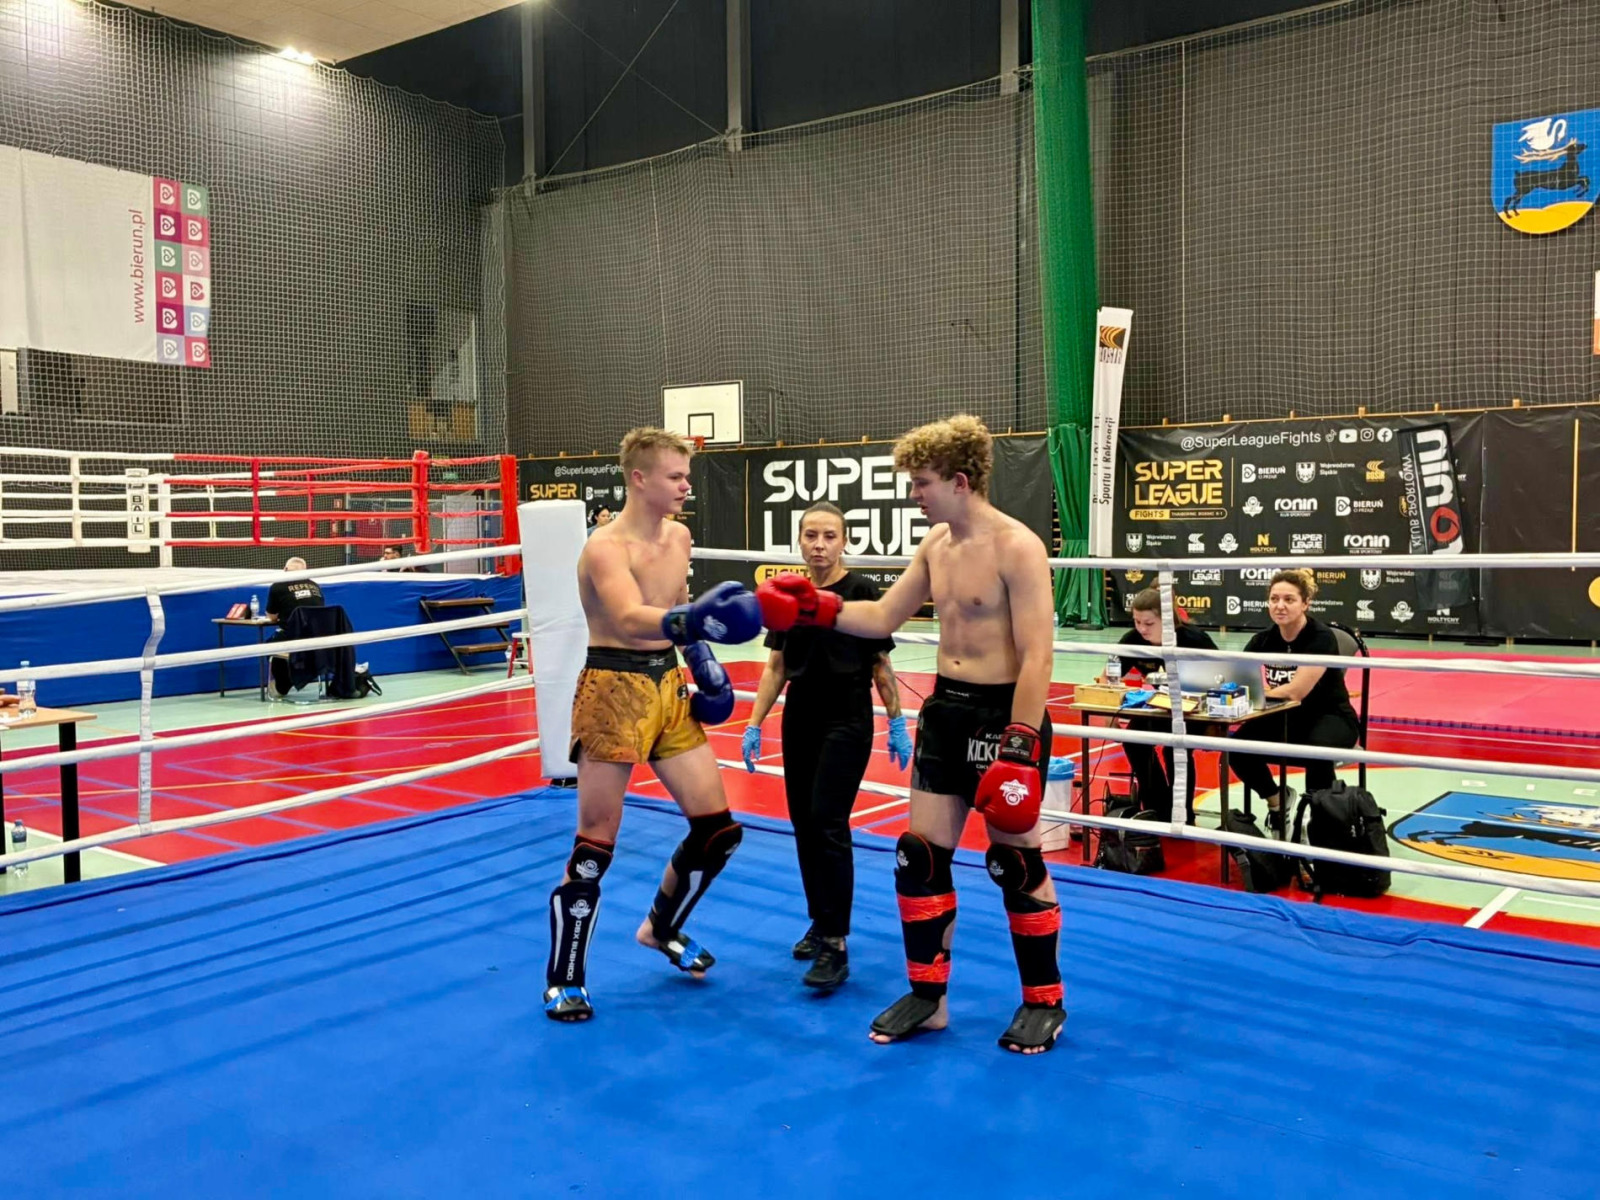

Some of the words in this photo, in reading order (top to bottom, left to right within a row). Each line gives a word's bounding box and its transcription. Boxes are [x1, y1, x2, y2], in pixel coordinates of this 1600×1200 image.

[128, 208, 146, 324] www.bierun.pl
[1180, 430, 1322, 451] @SuperLeagueFights
[1135, 459, 1223, 481] SUPER
[1257, 465, 1286, 475] BIERUŃ
[530, 483, 577, 498] SUPER
[1098, 473, 1112, 505] Sportu
[1135, 482, 1223, 506] LEAGUE
[1274, 498, 1318, 511] ronin
[1353, 499, 1383, 508] BIERUŃ
[1291, 533, 1323, 541] SUPER
[1343, 534, 1390, 548] ronin
[1317, 570, 1346, 580] BIERUŃ
[1265, 669, 1297, 682] SUPE
